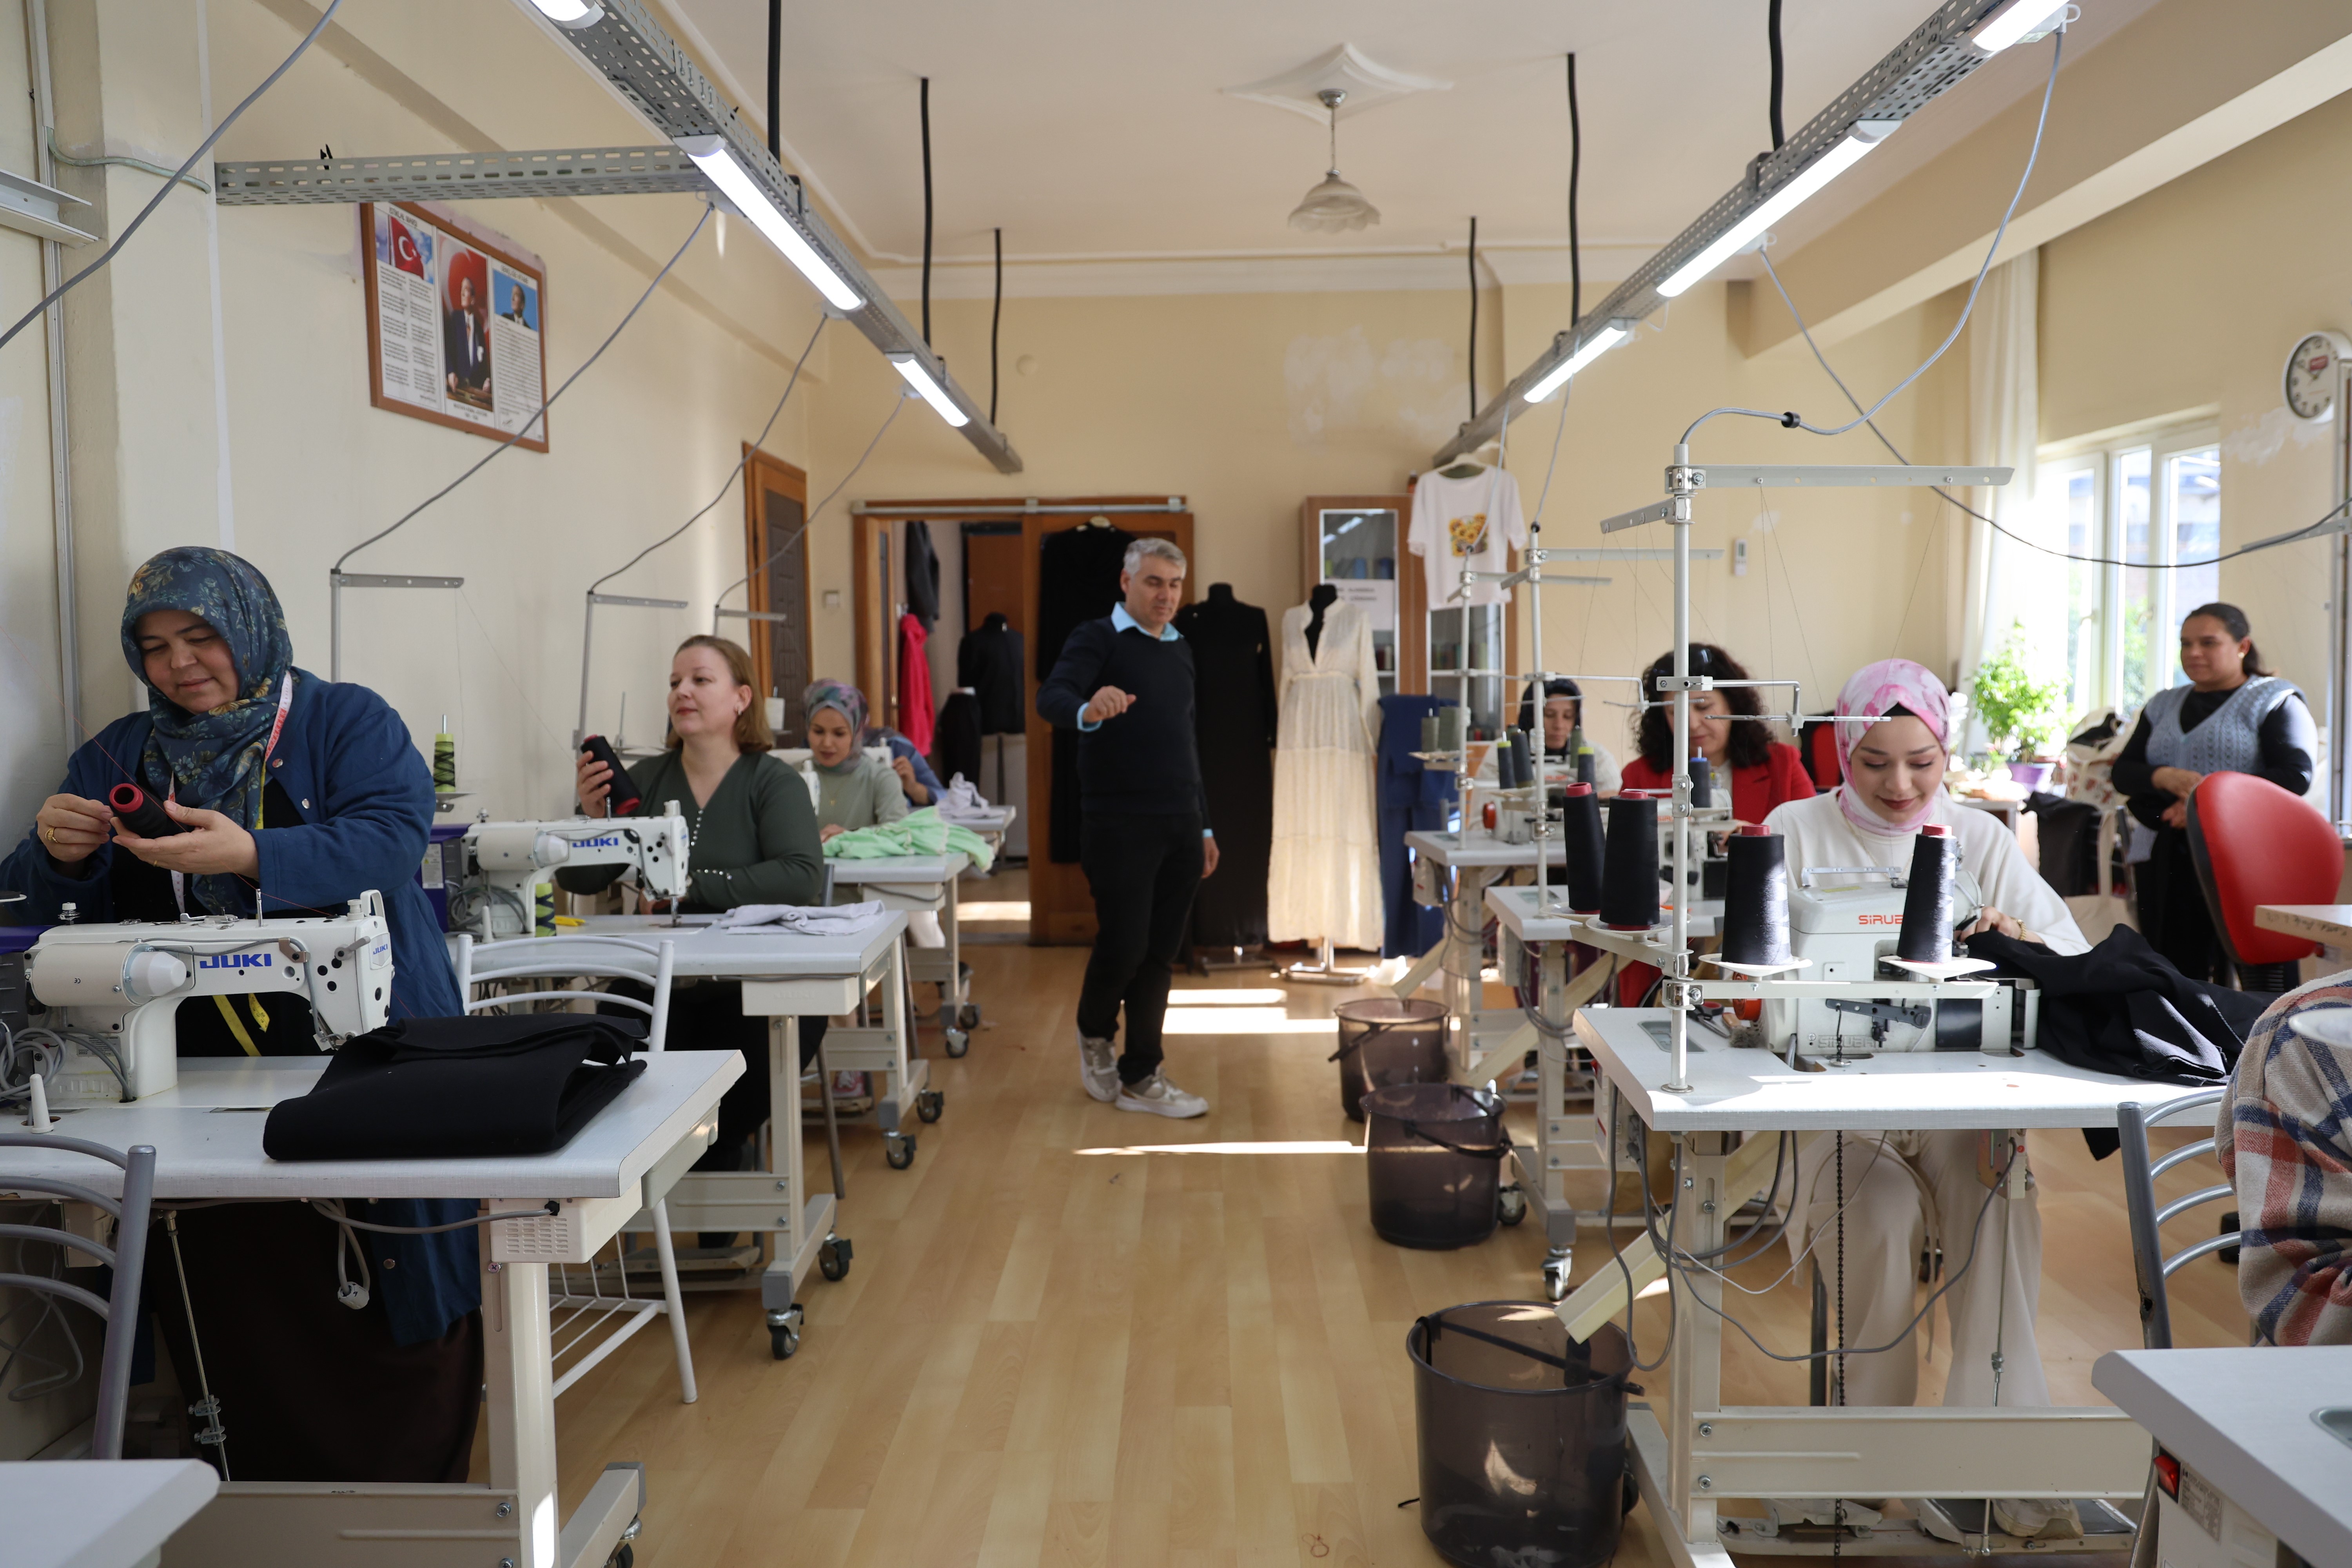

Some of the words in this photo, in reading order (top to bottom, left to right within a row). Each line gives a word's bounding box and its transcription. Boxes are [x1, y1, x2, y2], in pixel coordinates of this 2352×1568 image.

[573, 837, 618, 847] JUKI
[373, 944, 388, 955] JUKI
[200, 953, 272, 969] JUKI
